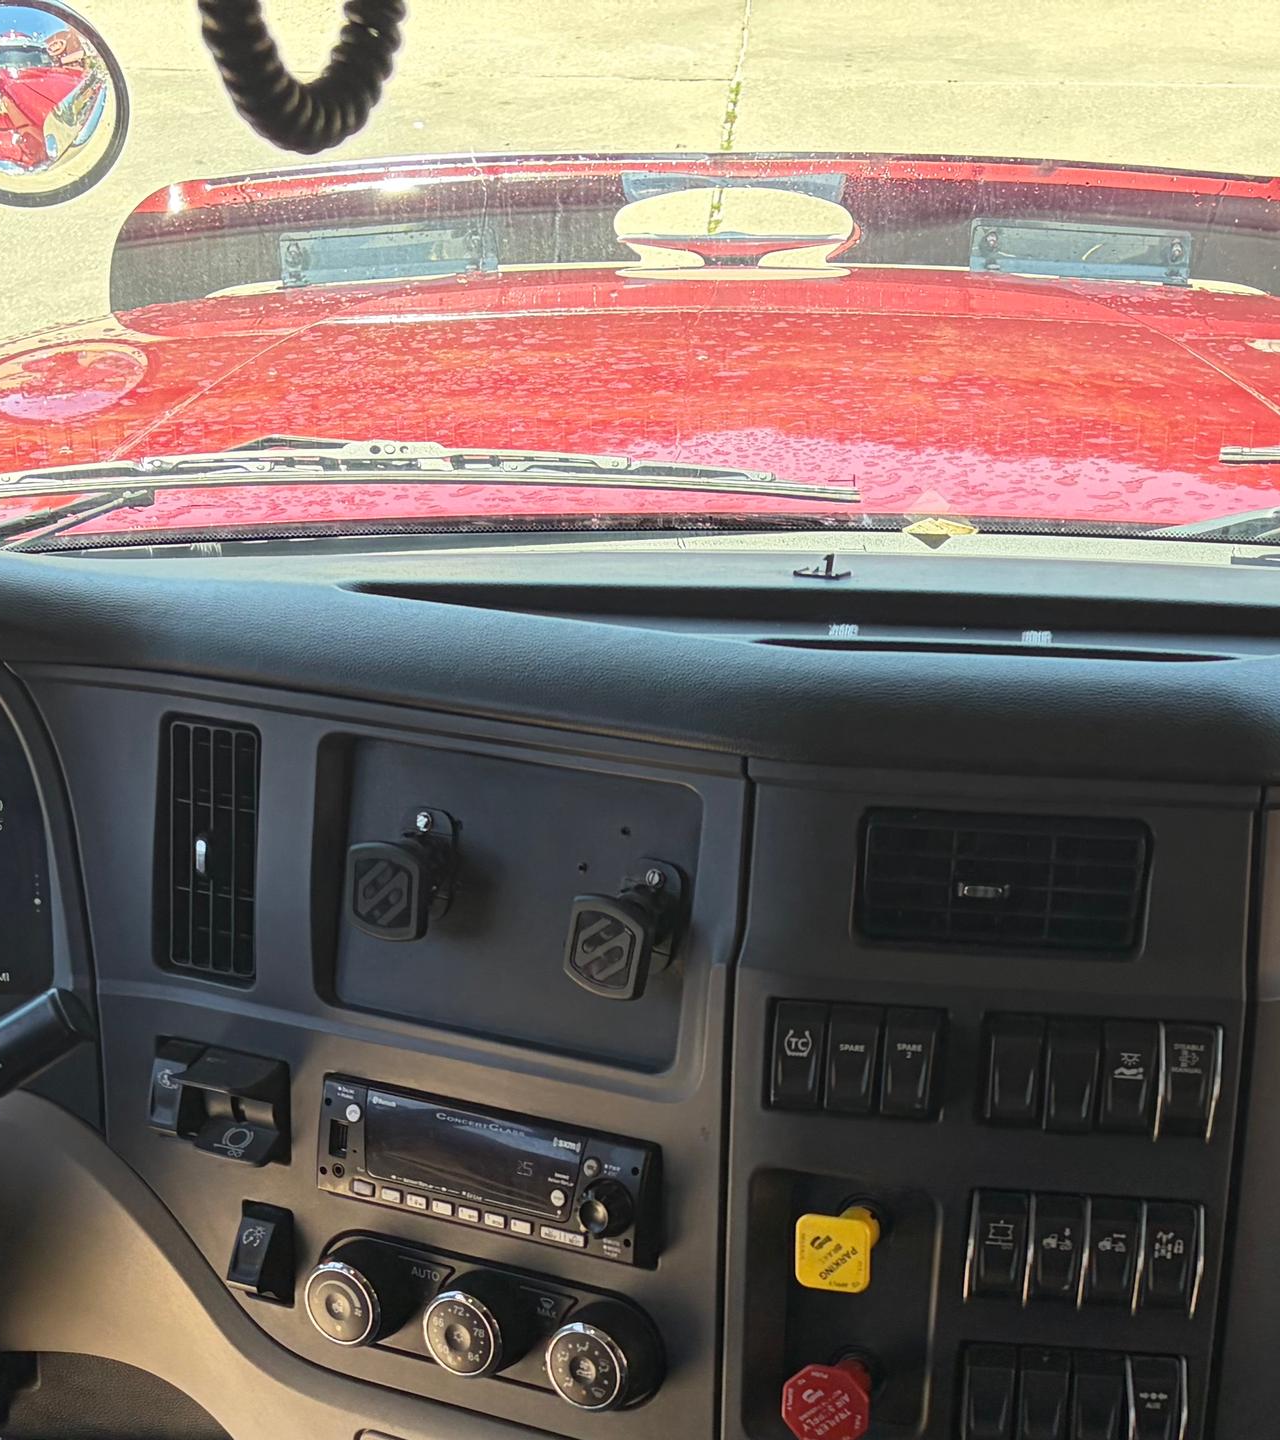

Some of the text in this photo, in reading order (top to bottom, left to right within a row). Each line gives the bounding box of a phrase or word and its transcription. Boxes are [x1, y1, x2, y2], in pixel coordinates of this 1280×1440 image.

[789, 1037, 808, 1051] TC
[839, 1043, 865, 1053] SPARE
[896, 1043, 922, 1052] SPARE
[818, 1246, 858, 1280] PARKING
[410, 1266, 440, 1282] AUTO
[453, 1304, 465, 1317] 72
[536, 1306, 558, 1319] MAX
[473, 1327, 485, 1338] 78
